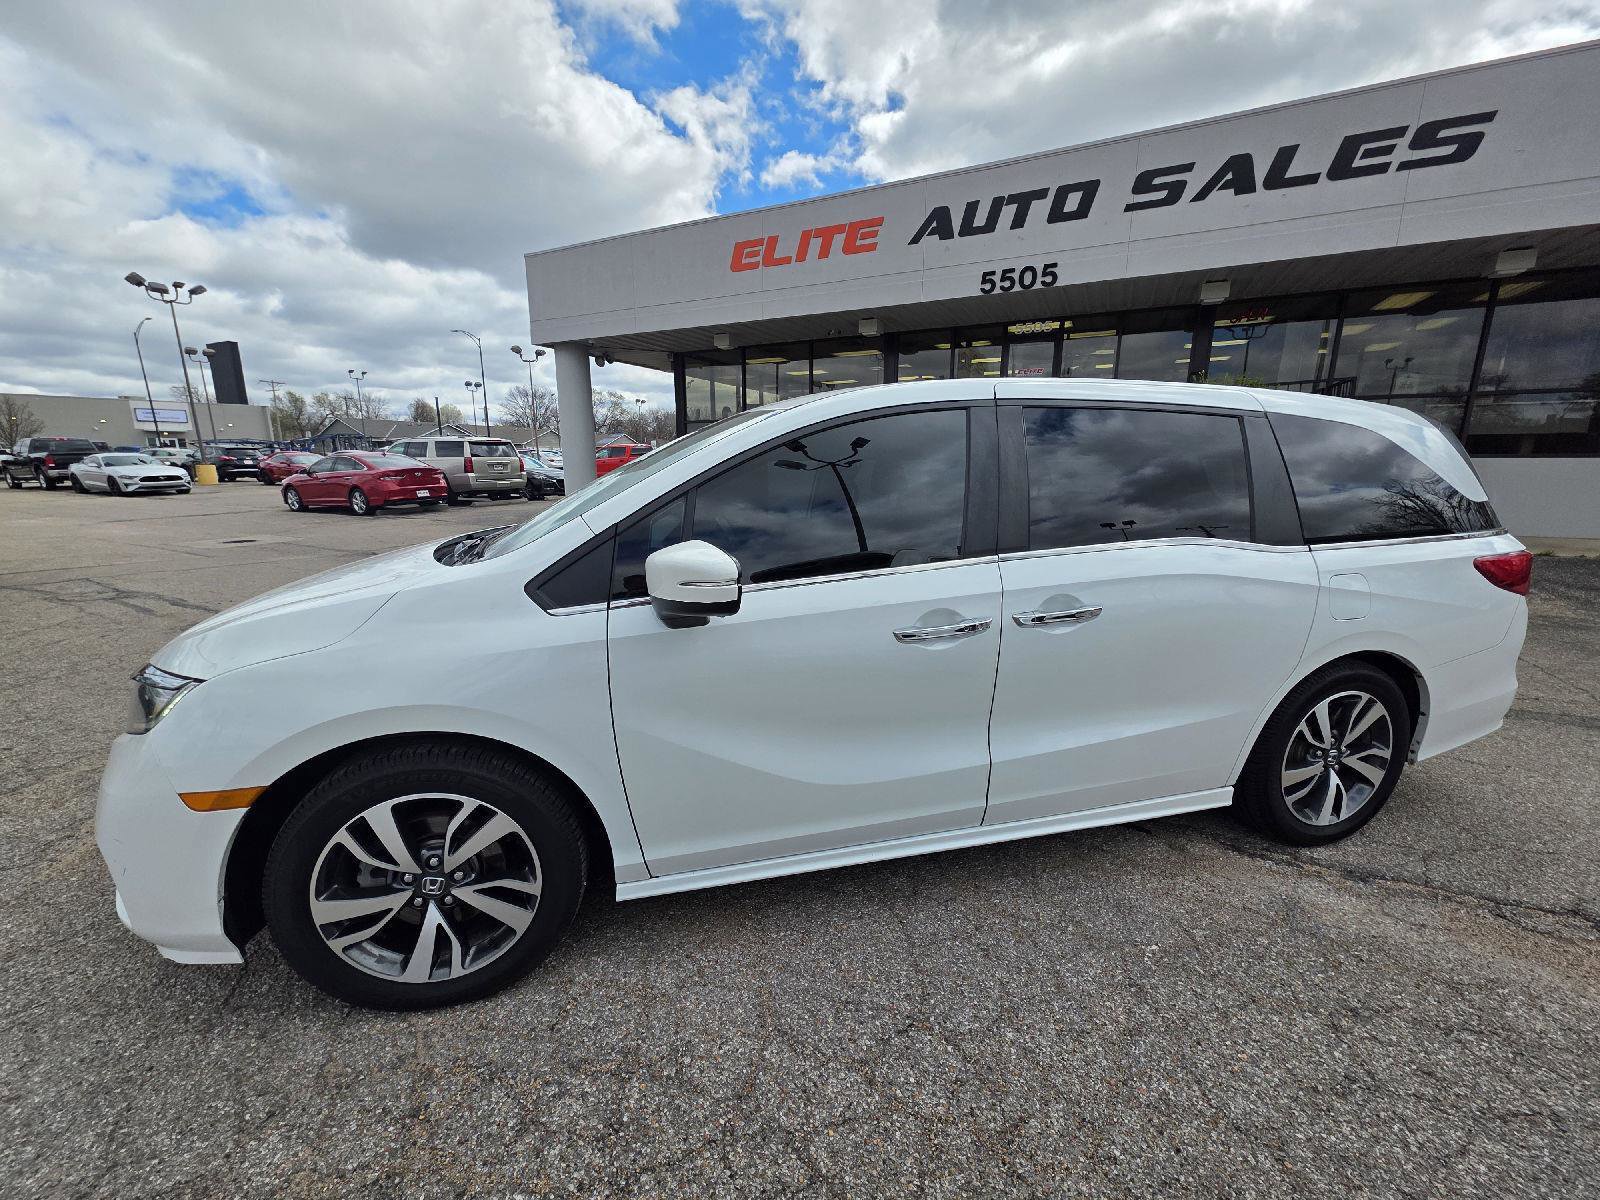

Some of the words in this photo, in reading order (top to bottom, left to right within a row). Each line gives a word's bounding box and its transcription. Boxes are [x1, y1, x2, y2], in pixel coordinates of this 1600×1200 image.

[730, 216, 885, 272] ELITE
[907, 178, 1101, 246] AUTO
[1123, 109, 1499, 213] SALES
[979, 262, 1059, 295] 5505
